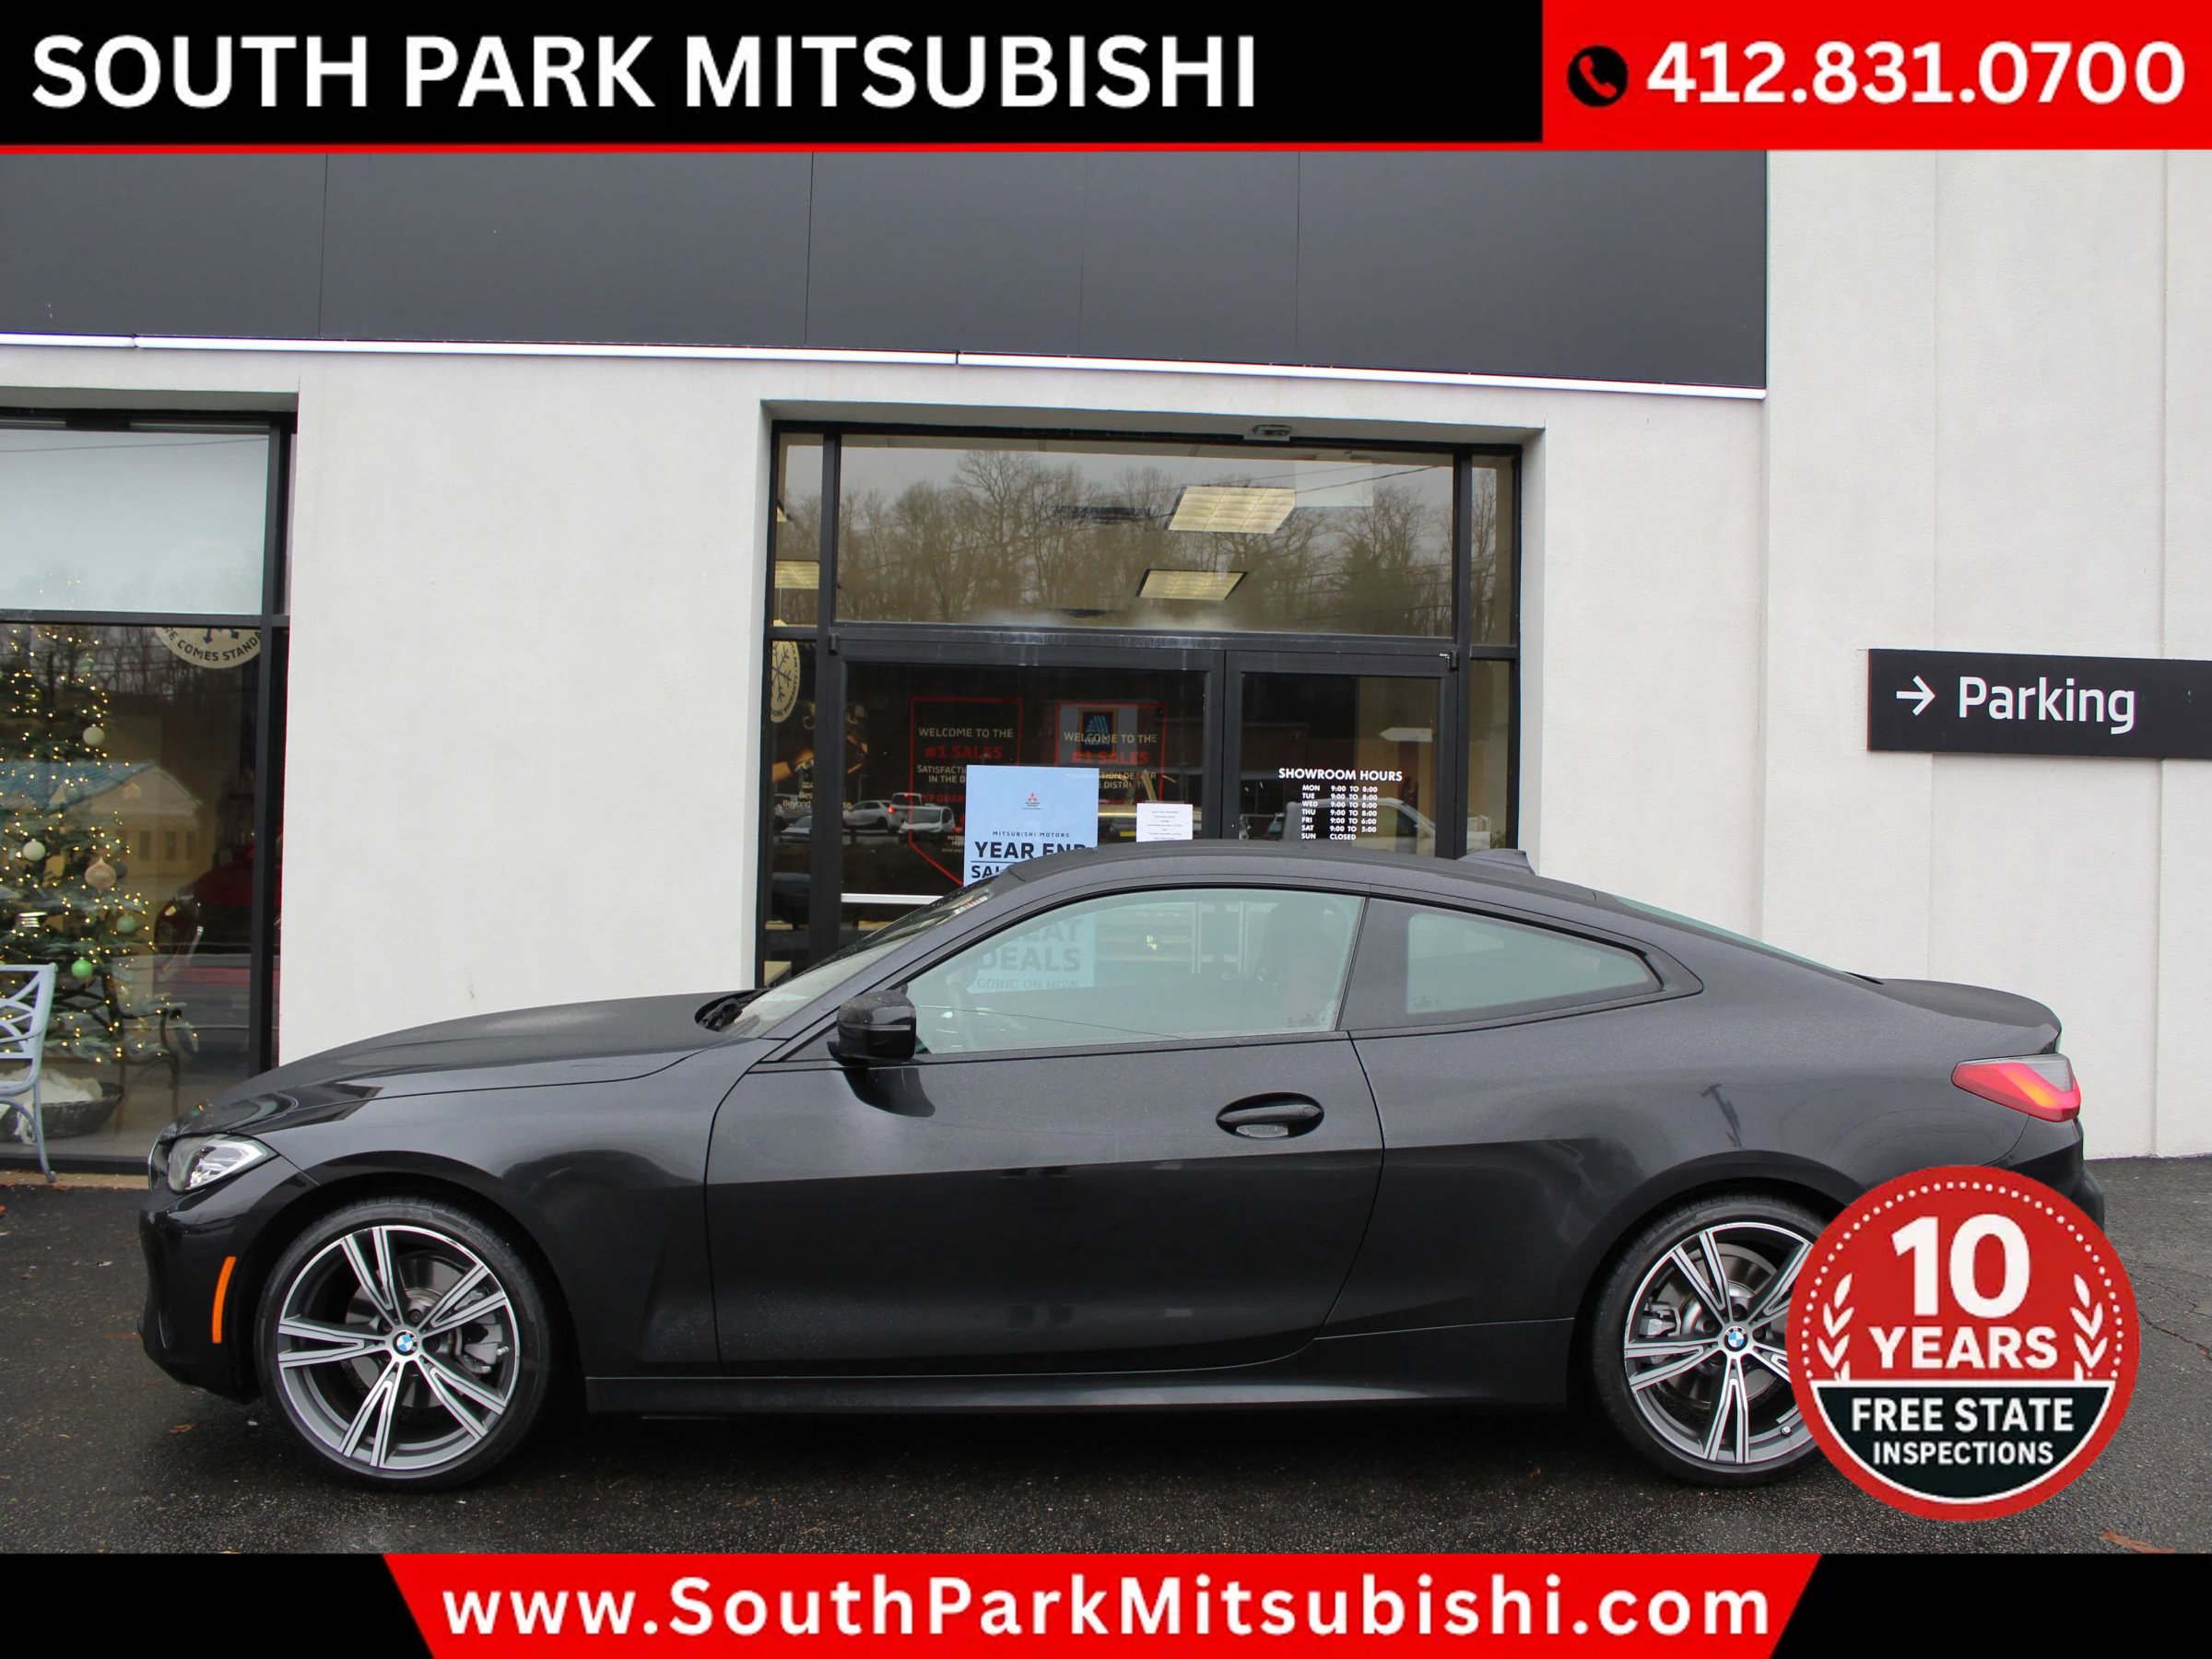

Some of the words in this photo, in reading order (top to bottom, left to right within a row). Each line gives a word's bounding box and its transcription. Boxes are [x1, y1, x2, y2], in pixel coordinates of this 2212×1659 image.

[177, 640, 219, 662] COMES
[1959, 676, 2136, 735] Parking
[919, 727, 973, 737] WELCOME
[974, 728, 990, 737] TO
[993, 728, 1014, 737] THE
[1064, 732, 1117, 744] WELCOME
[1121, 734, 1135, 743] TO
[1138, 734, 1158, 743] THE
[951, 745, 1004, 759] SALES
[928, 775, 938, 783] IN
[940, 775, 958, 783] THE
[1278, 768, 1357, 781] SHOWROOM
[1359, 770, 1403, 782] HOURS
[974, 841, 1034, 859] YEAR
[977, 978, 1018, 990] GOING
[1023, 978, 1042, 990] ON
[1047, 979, 1079, 990] NOW
